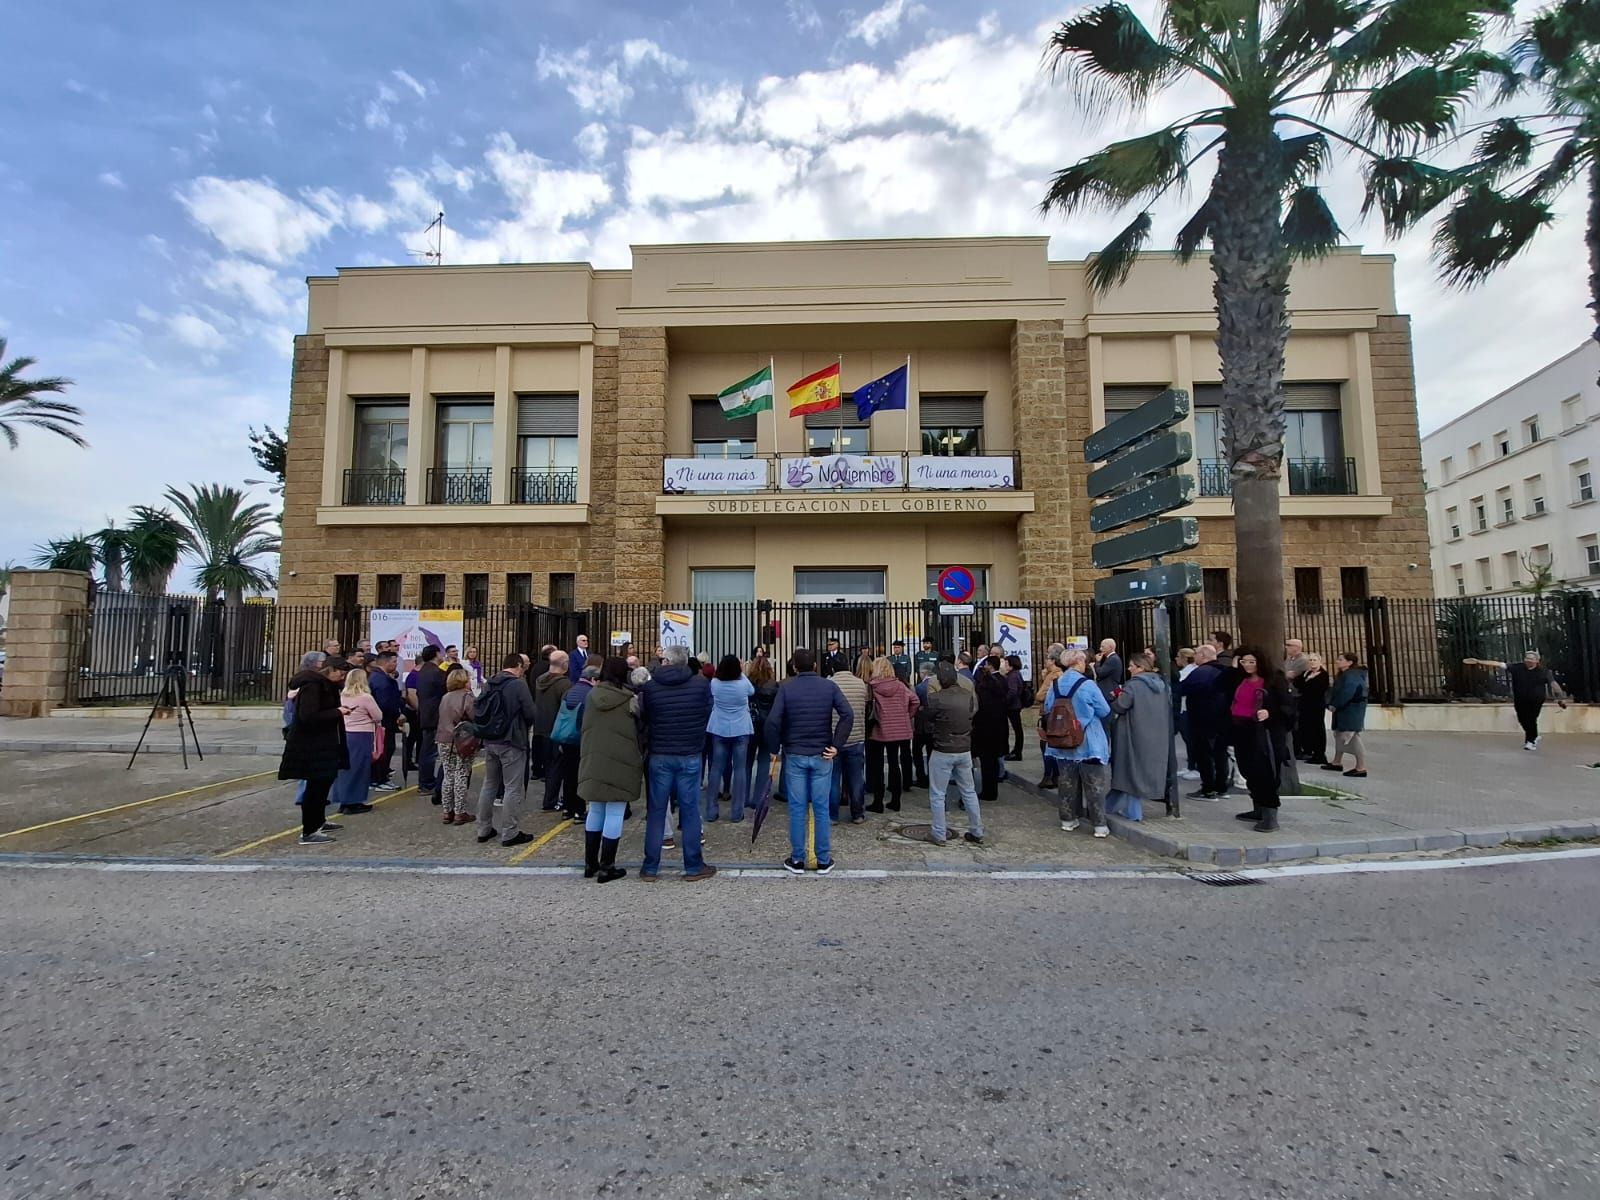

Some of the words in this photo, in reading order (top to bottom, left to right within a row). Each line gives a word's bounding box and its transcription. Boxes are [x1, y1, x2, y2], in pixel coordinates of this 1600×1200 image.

[676, 466, 694, 481] Ni
[697, 471, 723, 481] una
[727, 468, 756, 481] más
[787, 465, 813, 484] 25
[819, 464, 895, 483] Noviembre
[917, 464, 933, 479] Ni
[935, 469, 958, 478] una
[960, 468, 998, 479] menos
[707, 500, 851, 513] SUBDELEGACION
[860, 500, 891, 512] DEL
[902, 499, 987, 511] GOBIERNO
[372, 612, 388, 621] 016
